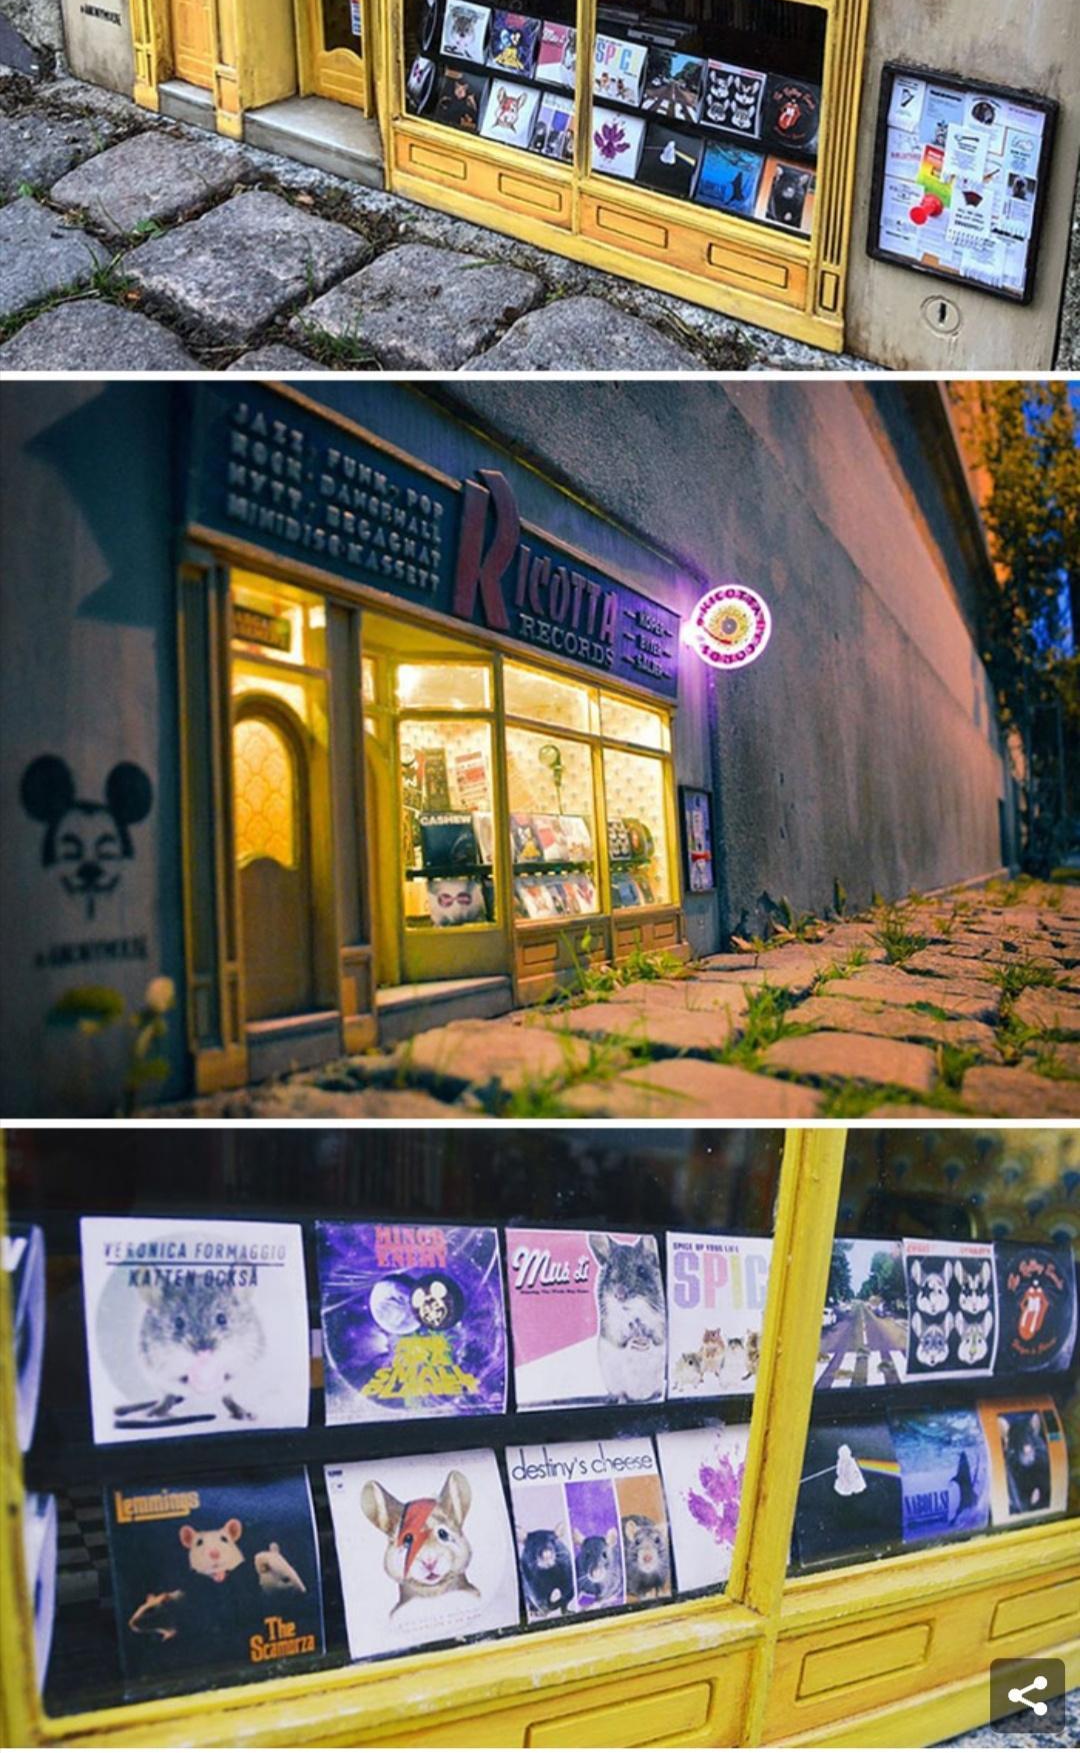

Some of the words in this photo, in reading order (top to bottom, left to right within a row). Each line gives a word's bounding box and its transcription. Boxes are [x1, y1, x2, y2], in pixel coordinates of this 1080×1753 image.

[235, 403, 303, 450] JAZZ
[328, 448, 386, 494] FUNK
[407, 488, 443, 518] POP
[229, 461, 302, 510] NYTT
[231, 431, 302, 480] ROCK
[321, 474, 441, 544] DANCEHALL
[520, 613, 614, 667] RECORDS
[104, 1242, 187, 1259] VERONICA
[194, 1242, 286, 1260] FORMAGGIO
[129, 1267, 195, 1288] KATTEN
[203, 1264, 258, 1287] OCKSÅ
[674, 1251, 768, 1309] SPIC
[512, 1447, 587, 1480] destiny's
[591, 1443, 652, 1473] cheese
[114, 1489, 199, 1523] Lemmings
[264, 1616, 295, 1640] The
